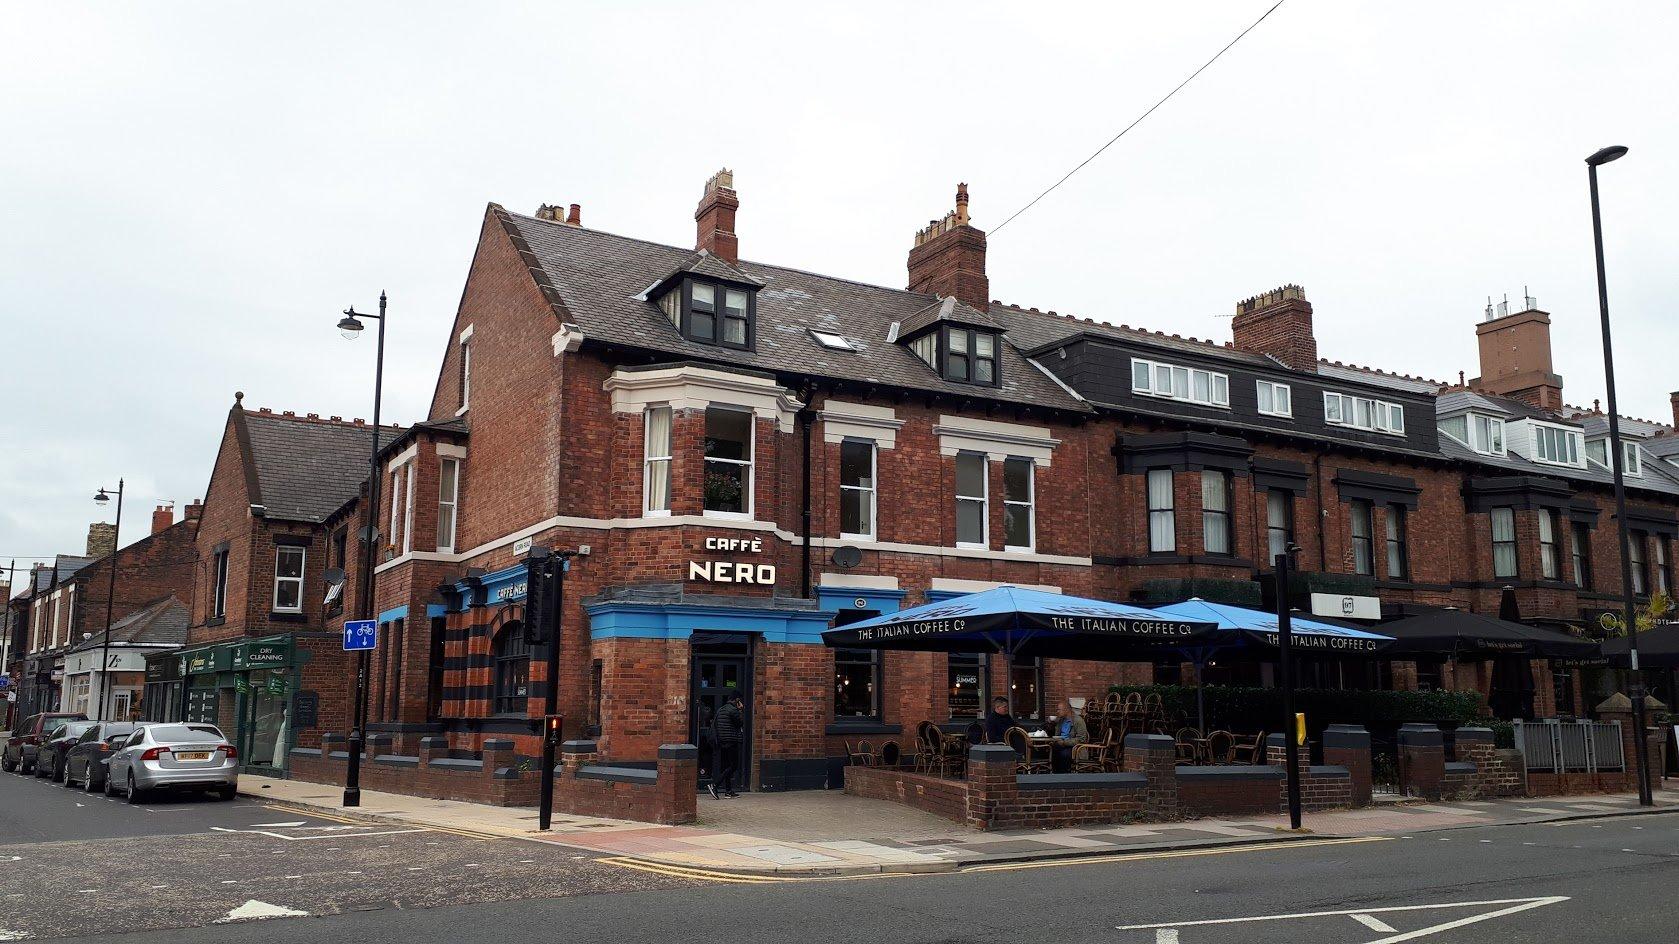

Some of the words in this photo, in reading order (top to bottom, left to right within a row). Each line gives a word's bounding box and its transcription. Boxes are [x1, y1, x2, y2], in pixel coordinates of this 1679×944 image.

[706, 536, 762, 553] CAFFÈ
[689, 560, 776, 585] NERO
[513, 582, 528, 596] NER
[858, 629, 873, 640] THE
[877, 624, 910, 638] ITALIAN
[913, 620, 949, 634] COFFEE
[1052, 617, 1075, 630] THE
[1082, 618, 1127, 632] ITALIAN
[1132, 621, 1175, 635] COFFEE
[1267, 633, 1280, 646] TH
[1290, 635, 1327, 648] ITALIAN
[1331, 638, 1364, 650] COFFEE
